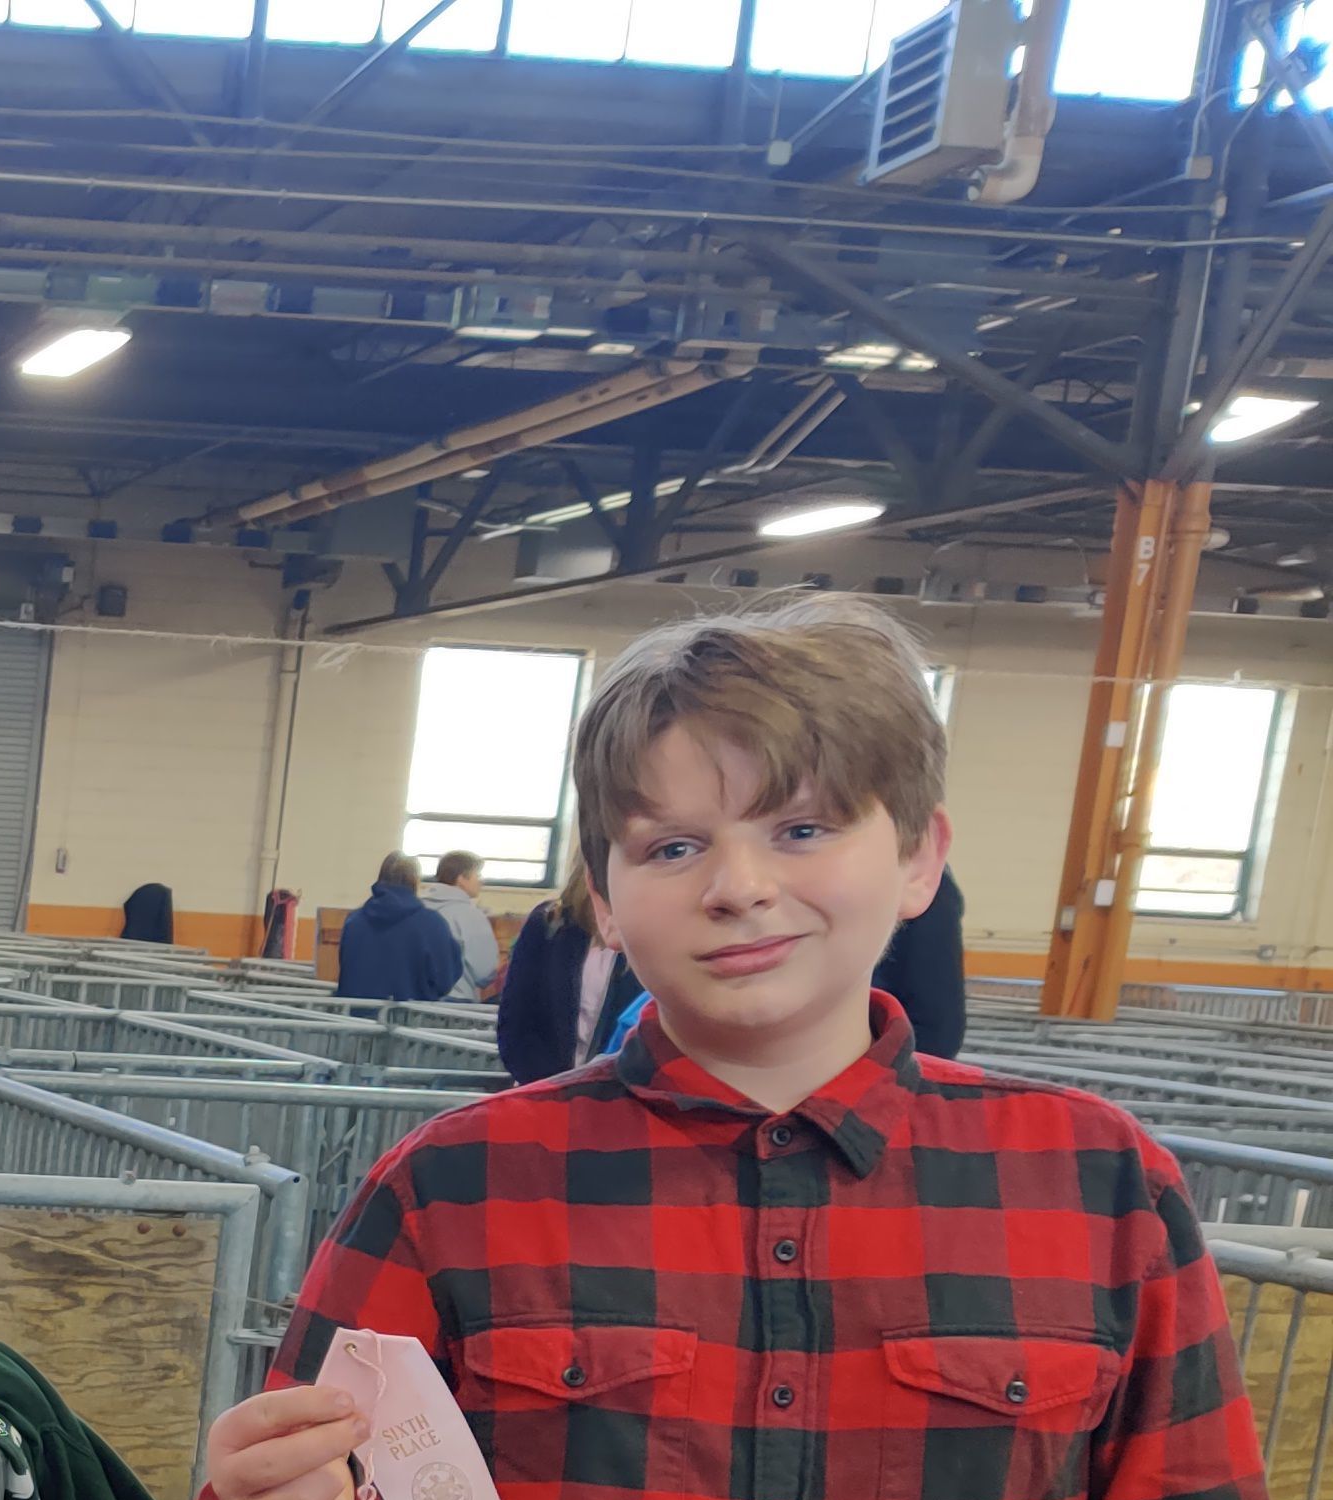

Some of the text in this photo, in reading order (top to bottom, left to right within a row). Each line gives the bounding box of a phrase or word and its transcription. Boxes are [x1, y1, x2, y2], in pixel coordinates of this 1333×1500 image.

[1139, 536, 1155, 560] B
[1137, 563, 1150, 586] 7
[382, 1413, 431, 1445] SIXTH
[389, 1429, 441, 1461] PLACE
